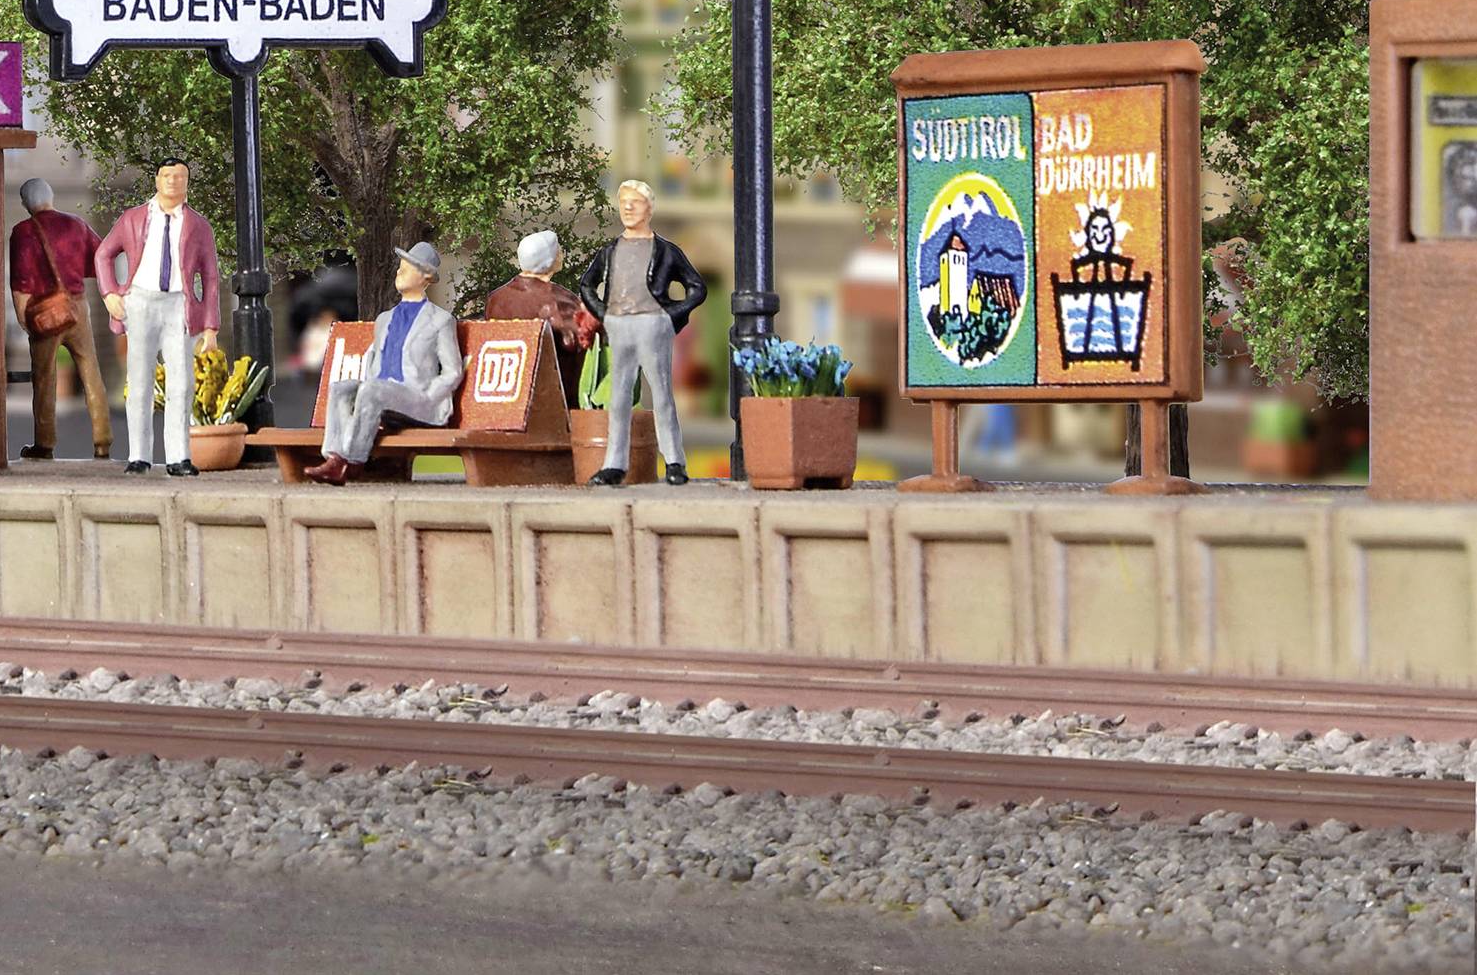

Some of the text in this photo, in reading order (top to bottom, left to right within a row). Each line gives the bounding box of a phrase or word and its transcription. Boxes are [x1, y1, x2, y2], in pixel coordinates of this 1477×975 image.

[912, 108, 1026, 162] SÜDTIROL
[1039, 114, 1093, 153] BAD
[1038, 152, 1156, 194] DÜRRHEIM
[479, 353, 519, 392] DB
